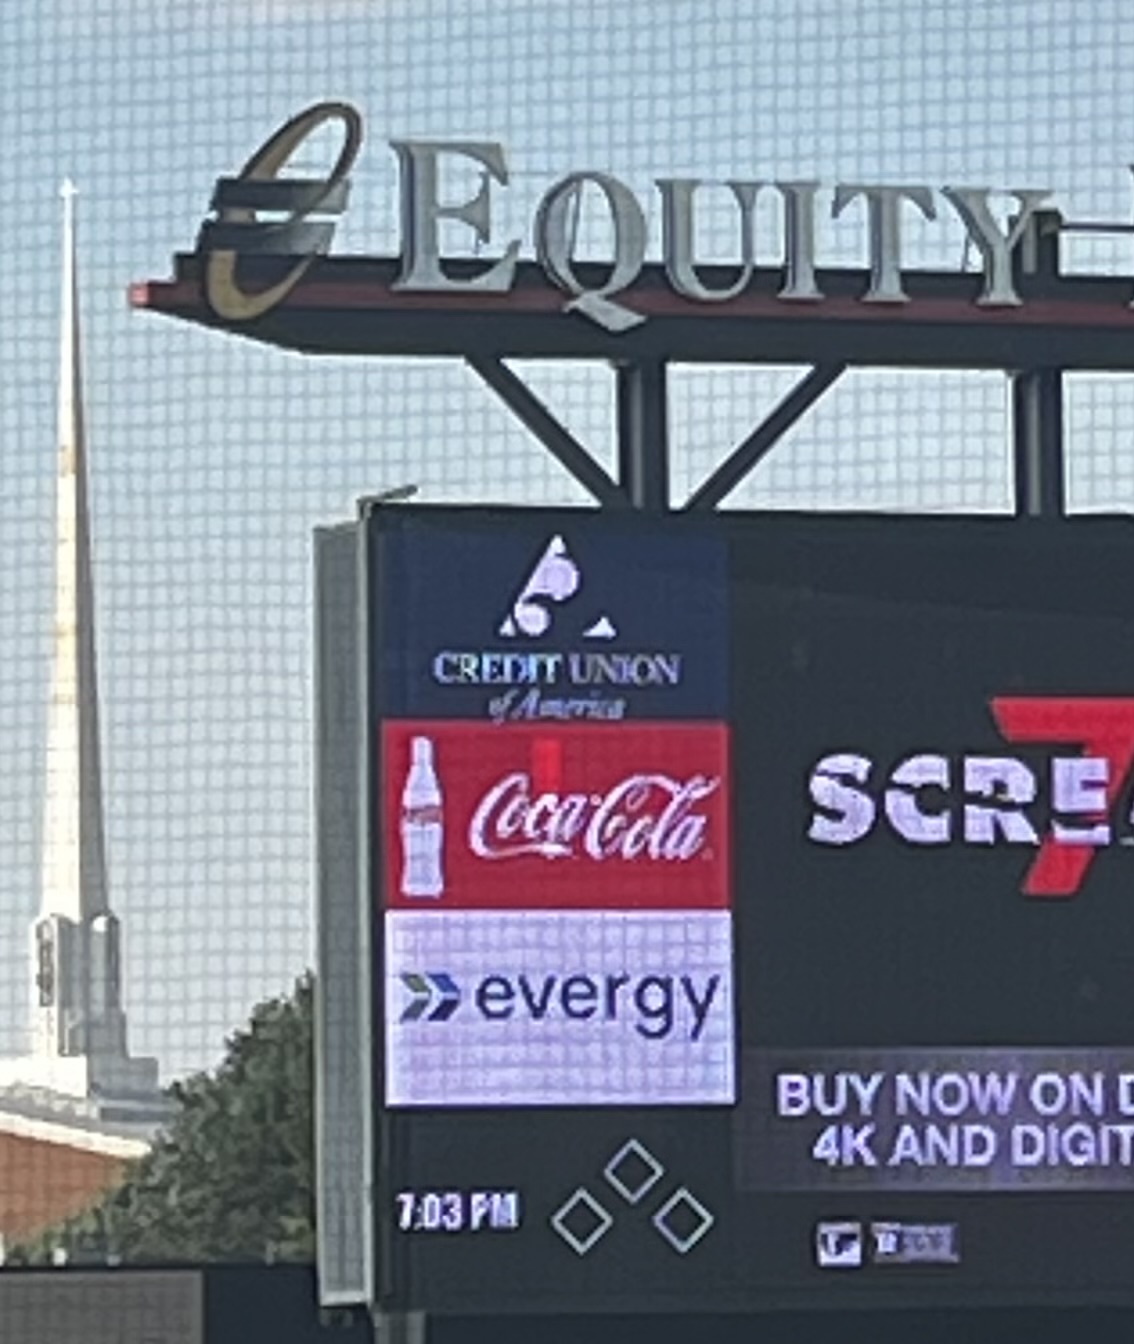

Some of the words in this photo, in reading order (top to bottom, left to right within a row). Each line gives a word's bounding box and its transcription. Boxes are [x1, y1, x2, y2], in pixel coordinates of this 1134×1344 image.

[388, 139, 1051, 332] EQUITY
[434, 651, 562, 685] CREDIT
[568, 652, 683, 685] UNION
[475, 971, 721, 1042] evergy
[776, 1071, 883, 1117] BUY
[895, 1071, 1016, 1117] NOW
[1029, 1071, 1104, 1117] ON
[811, 1123, 878, 1167] 4K
[887, 1123, 996, 1167] AND
[396, 1193, 463, 1231] 7:03
[470, 1193, 519, 1230] PM
